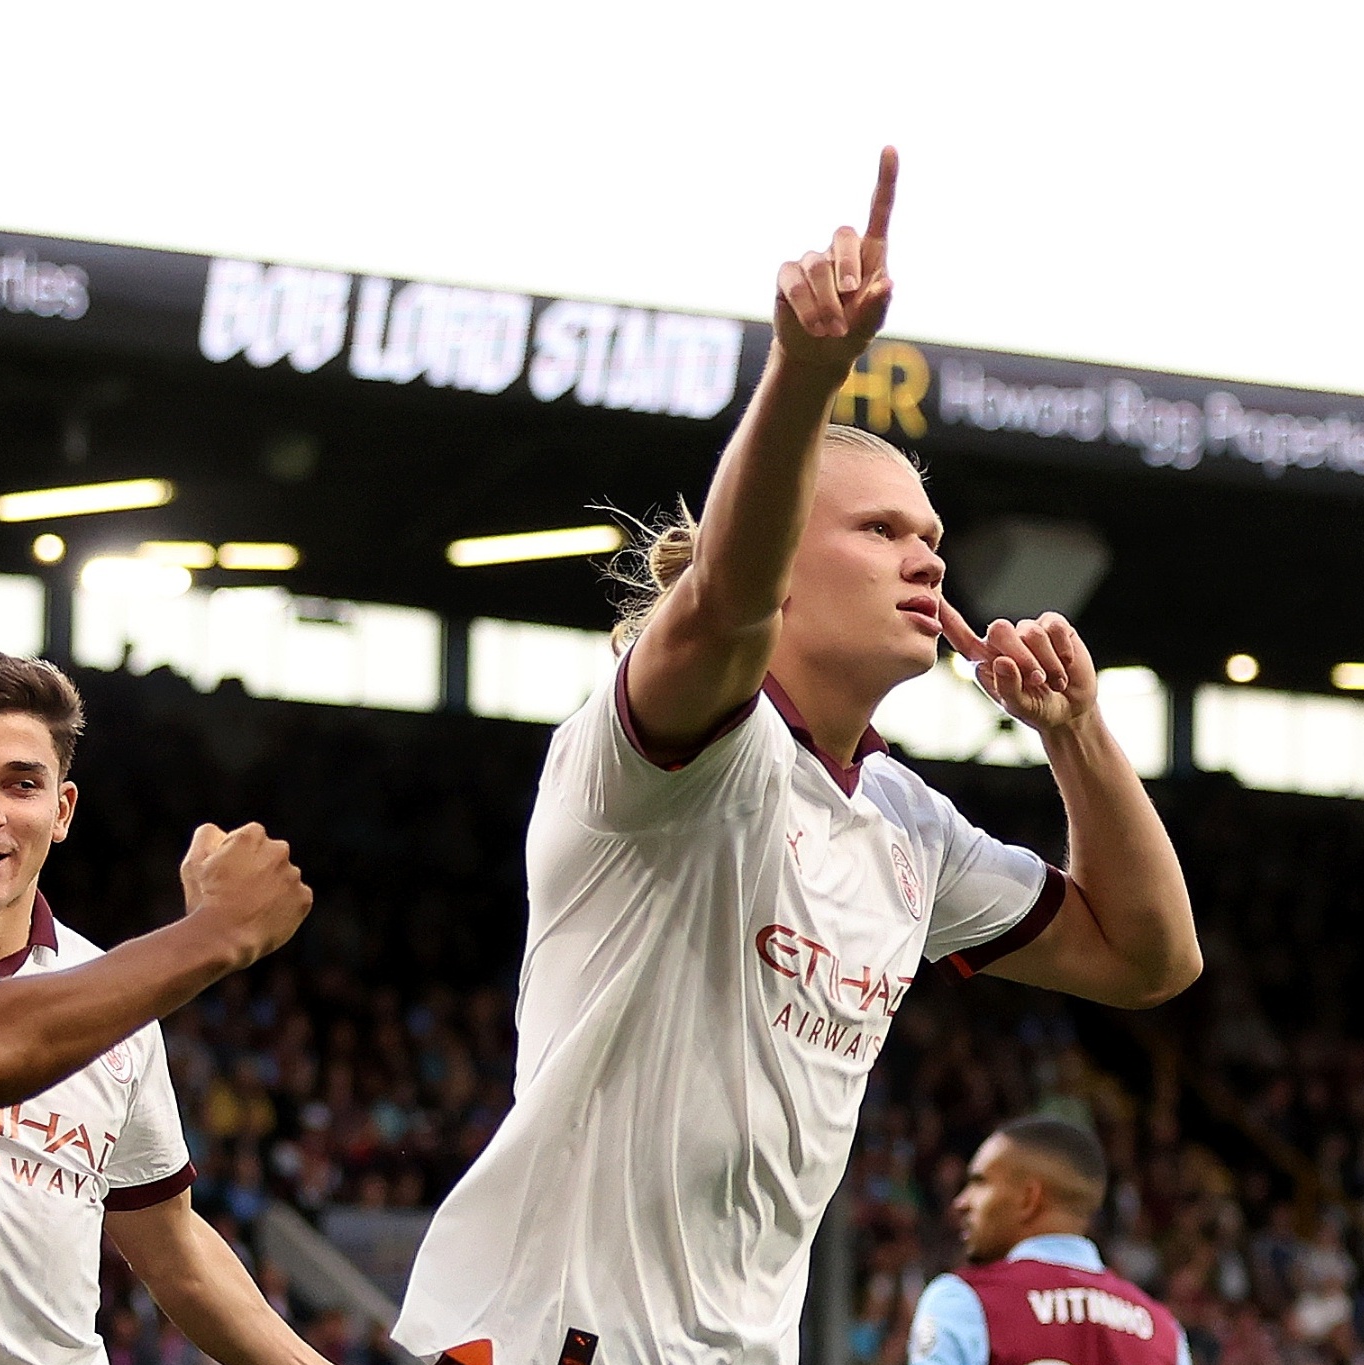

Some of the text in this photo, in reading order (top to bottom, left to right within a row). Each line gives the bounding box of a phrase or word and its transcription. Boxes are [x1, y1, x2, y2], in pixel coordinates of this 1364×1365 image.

[939, 356, 1104, 442] Howard
[1106, 378, 1203, 470] Rigg
[772, 1002, 881, 1062] AIRWAYS
